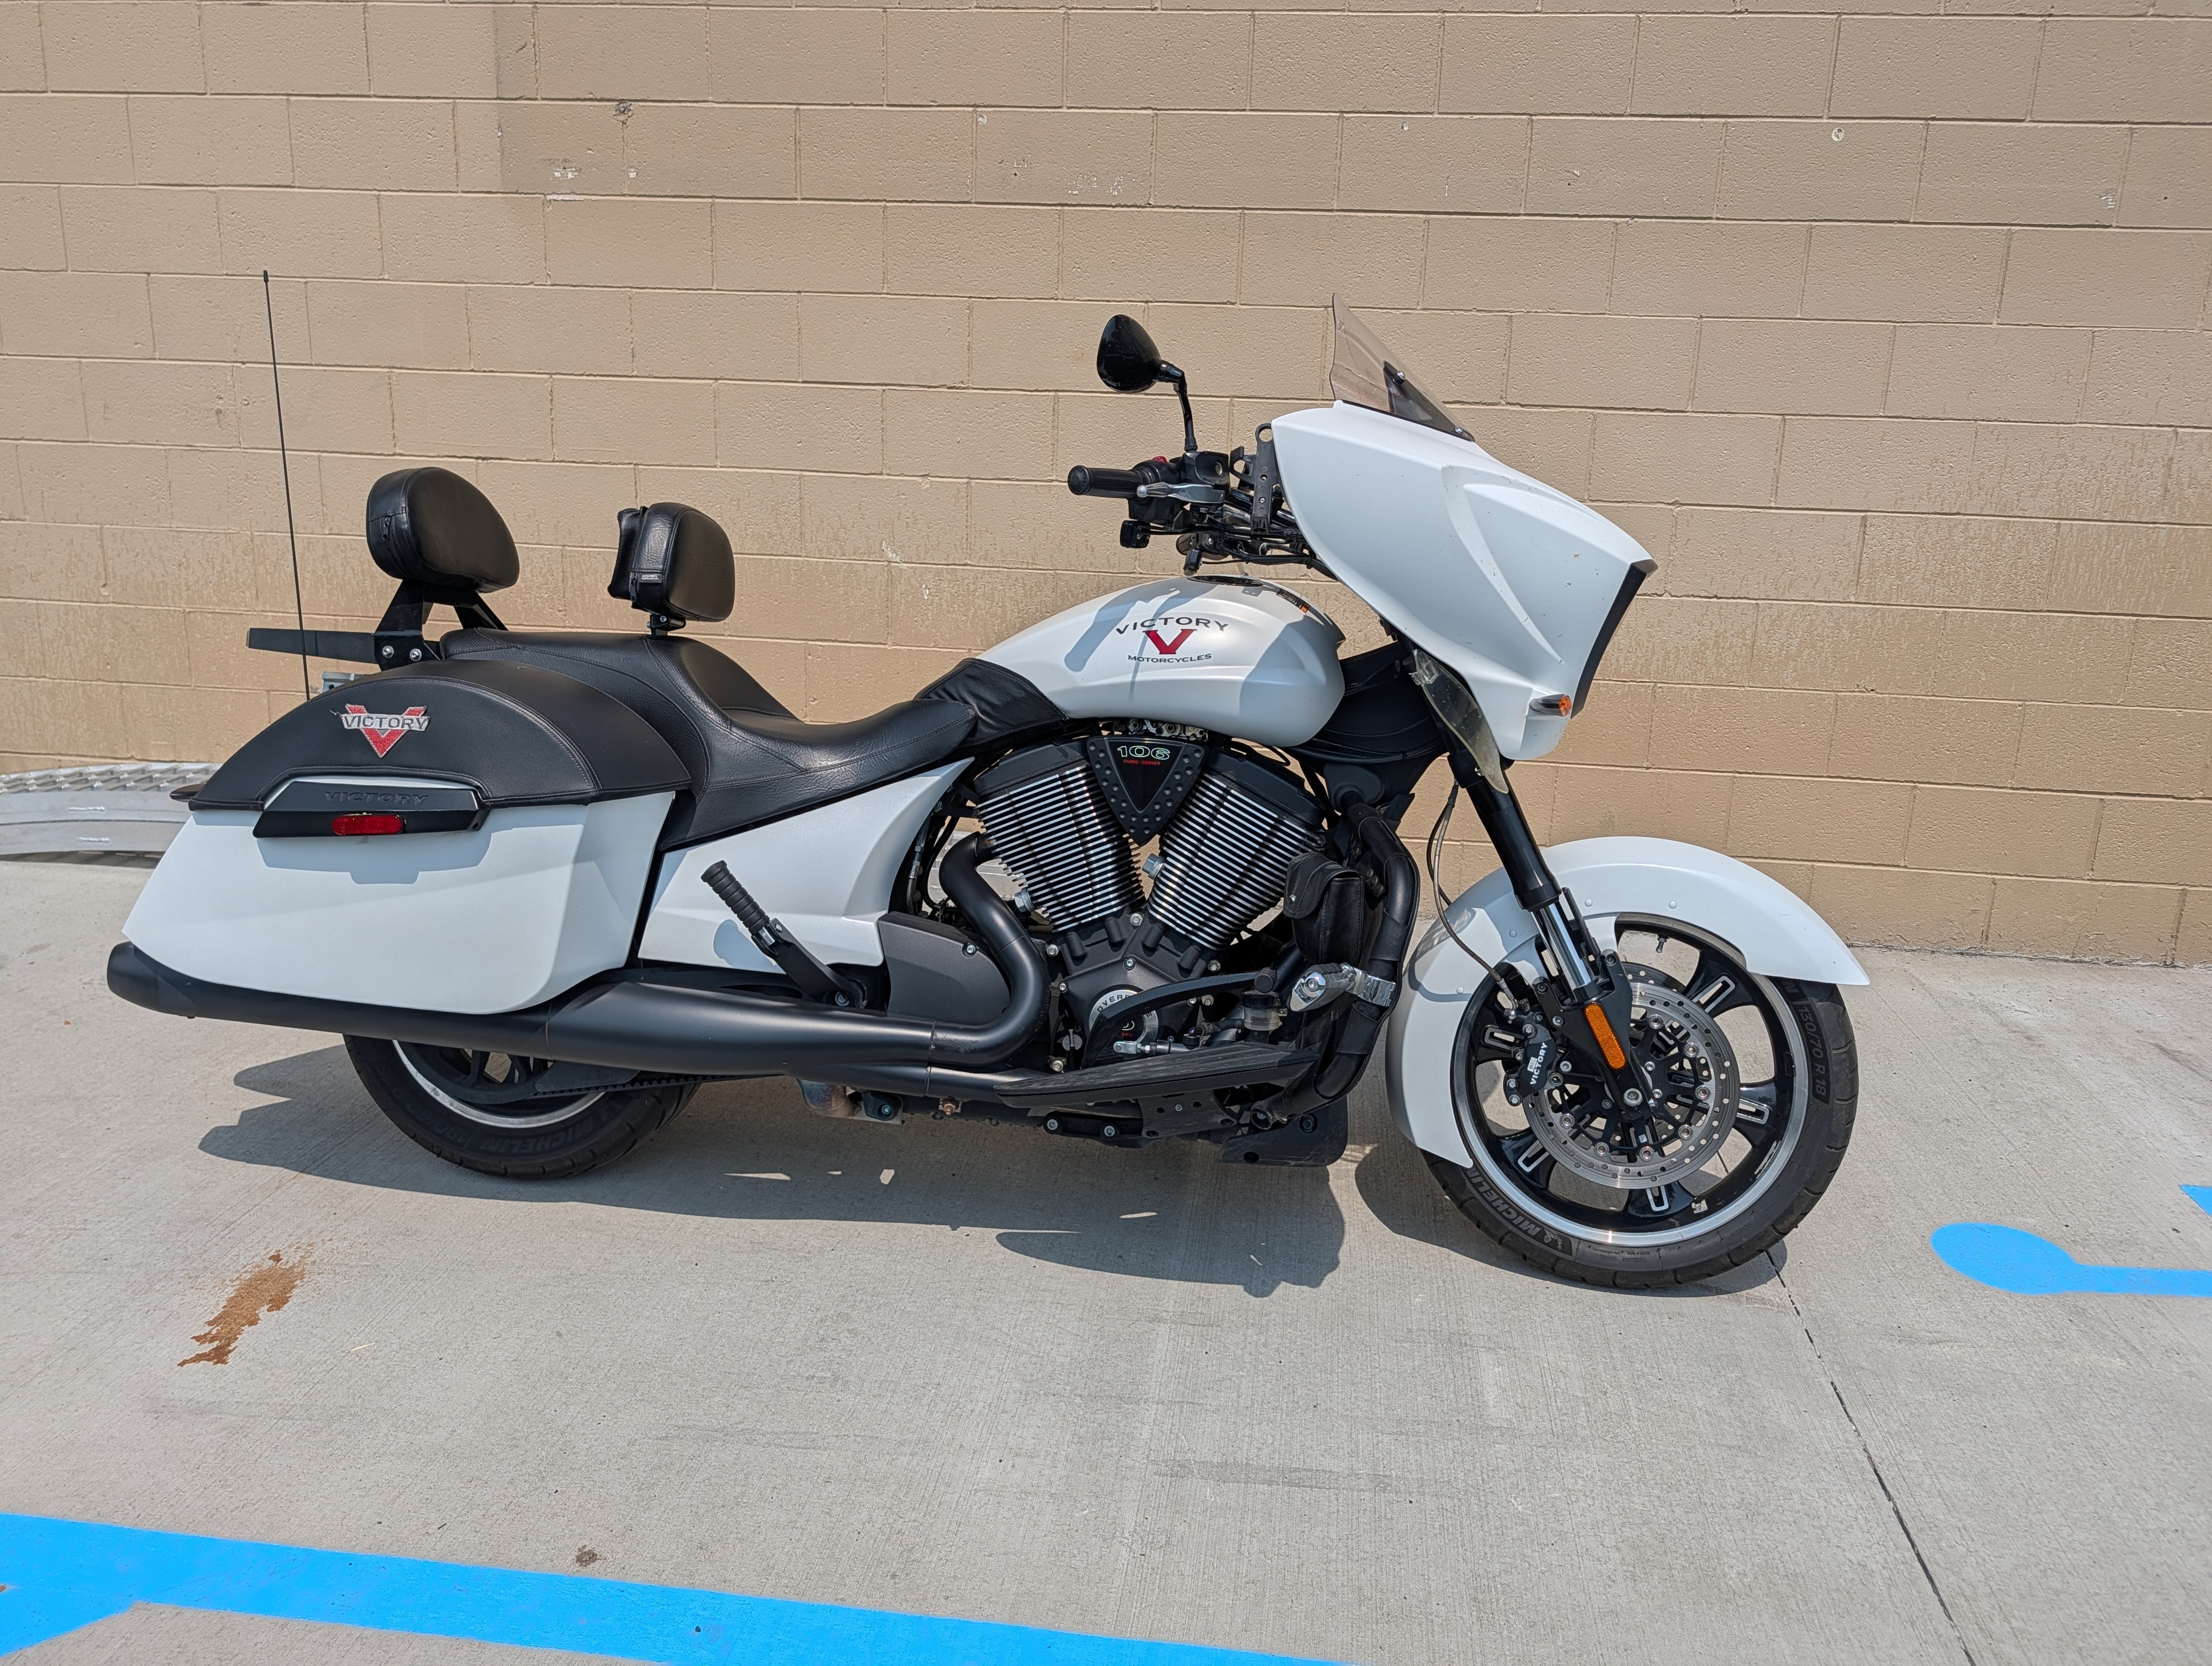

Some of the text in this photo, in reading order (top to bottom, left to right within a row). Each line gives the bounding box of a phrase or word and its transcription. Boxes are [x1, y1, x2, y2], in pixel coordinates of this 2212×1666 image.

[1115, 617, 1229, 635] VICTORY
[1128, 653, 1212, 663] MOTORCYCLES
[344, 716, 427, 729] VICTORY
[1117, 745, 1171, 760] 106
[325, 791, 428, 804] VICTORY
[1798, 1006, 1824, 1058] 130/70
[1530, 1042, 1548, 1085] VICTORY
[1814, 1063, 1825, 1075] R
[1816, 1081, 1827, 1097] 18
[479, 1114, 595, 1153] MICHELIN
[1466, 1167, 1541, 1236] MICHELIN
